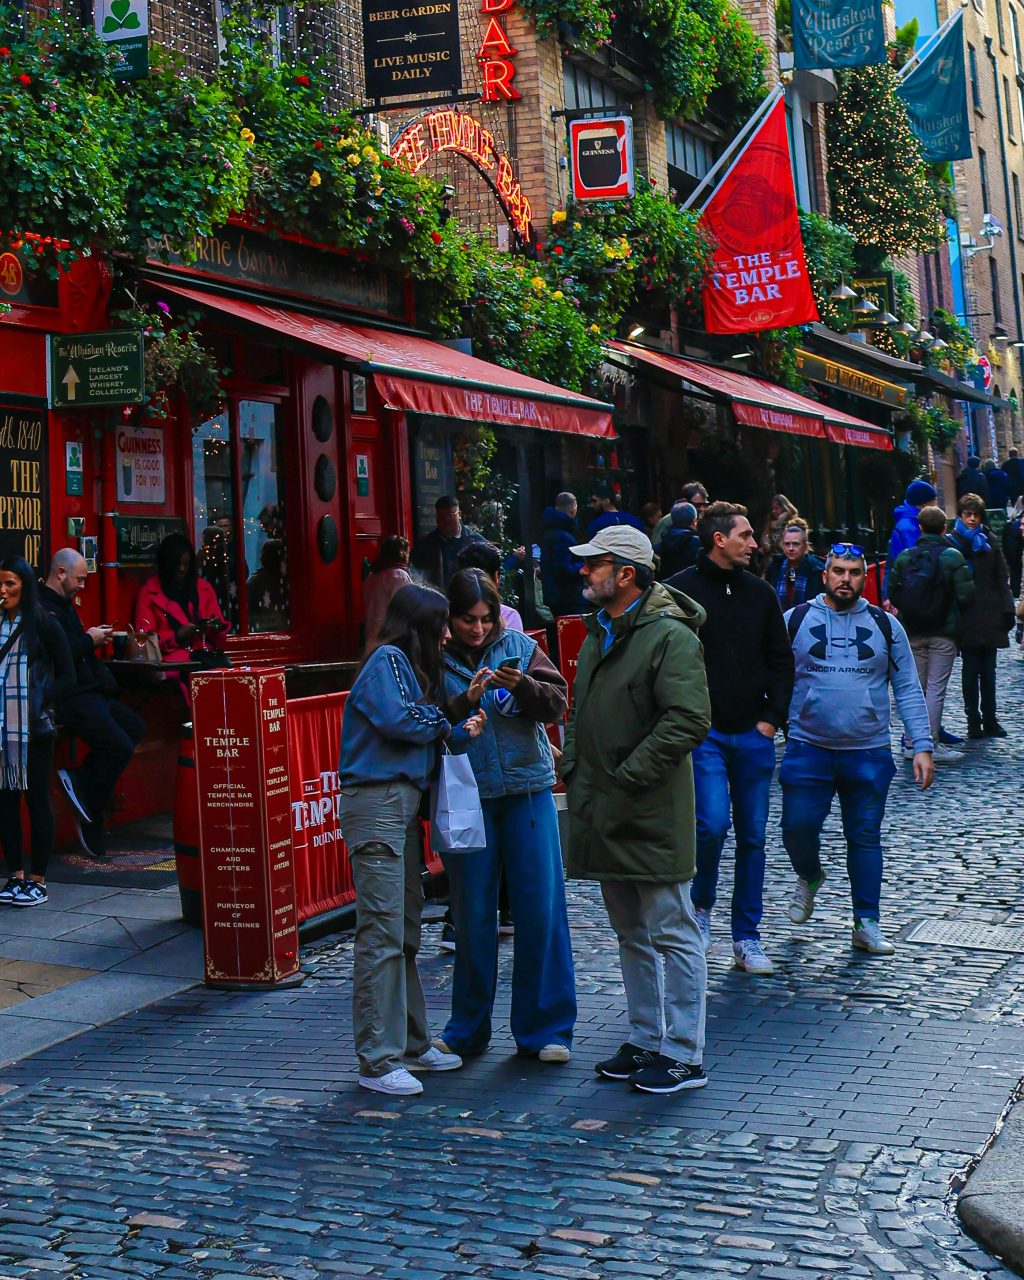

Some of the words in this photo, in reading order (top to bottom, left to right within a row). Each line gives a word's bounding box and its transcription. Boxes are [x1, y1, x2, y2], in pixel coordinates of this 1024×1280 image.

[369, 9, 400, 22] BEER
[401, 3, 451, 18] GARDEN
[799, 4, 876, 38] Whiskey
[373, 55, 405, 68] LIVE
[407, 50, 450, 65] MUSIC
[391, 67, 433, 81] DAILY
[581, 148, 615, 156] GUINNESS
[733, 251, 772, 270] THE
[0, 259, 17, 286] 48
[710, 260, 802, 290] TEMPLE
[734, 284, 783, 305] BAR
[68, 342, 105, 360] Whiskey
[106, 341, 138, 358] Reserve
[88, 365, 129, 373] IRELAND'S
[88, 373, 123, 381] LARGEST
[88, 380, 125, 388] WHISKEY
[88, 387, 138, 397] COLLECTION
[463, 389, 484, 413] THE
[485, 394, 519, 417] TEMPLE
[519, 400, 536, 420] BAR
[17, 420, 42, 451] 1840
[117, 432, 162, 456] GUINNESS
[134, 459, 141, 470] IS
[142, 459, 161, 471] GOOD
[10, 459, 41, 494] THE
[135, 474, 148, 487] FOR
[149, 474, 161, 487] YOU
[25, 534, 41, 568] OF
[806, 666, 837, 674] UNDER
[837, 666, 875, 675] ARMOUR
[268, 698, 278, 707] THE
[263, 706, 285, 719] TEMPLE
[216, 728, 236, 736] THE
[269, 720, 281, 733] BAR
[204, 737, 250, 747] TEMPLE
[216, 747, 240, 758] BAR
[305, 784, 315, 792] Est.
